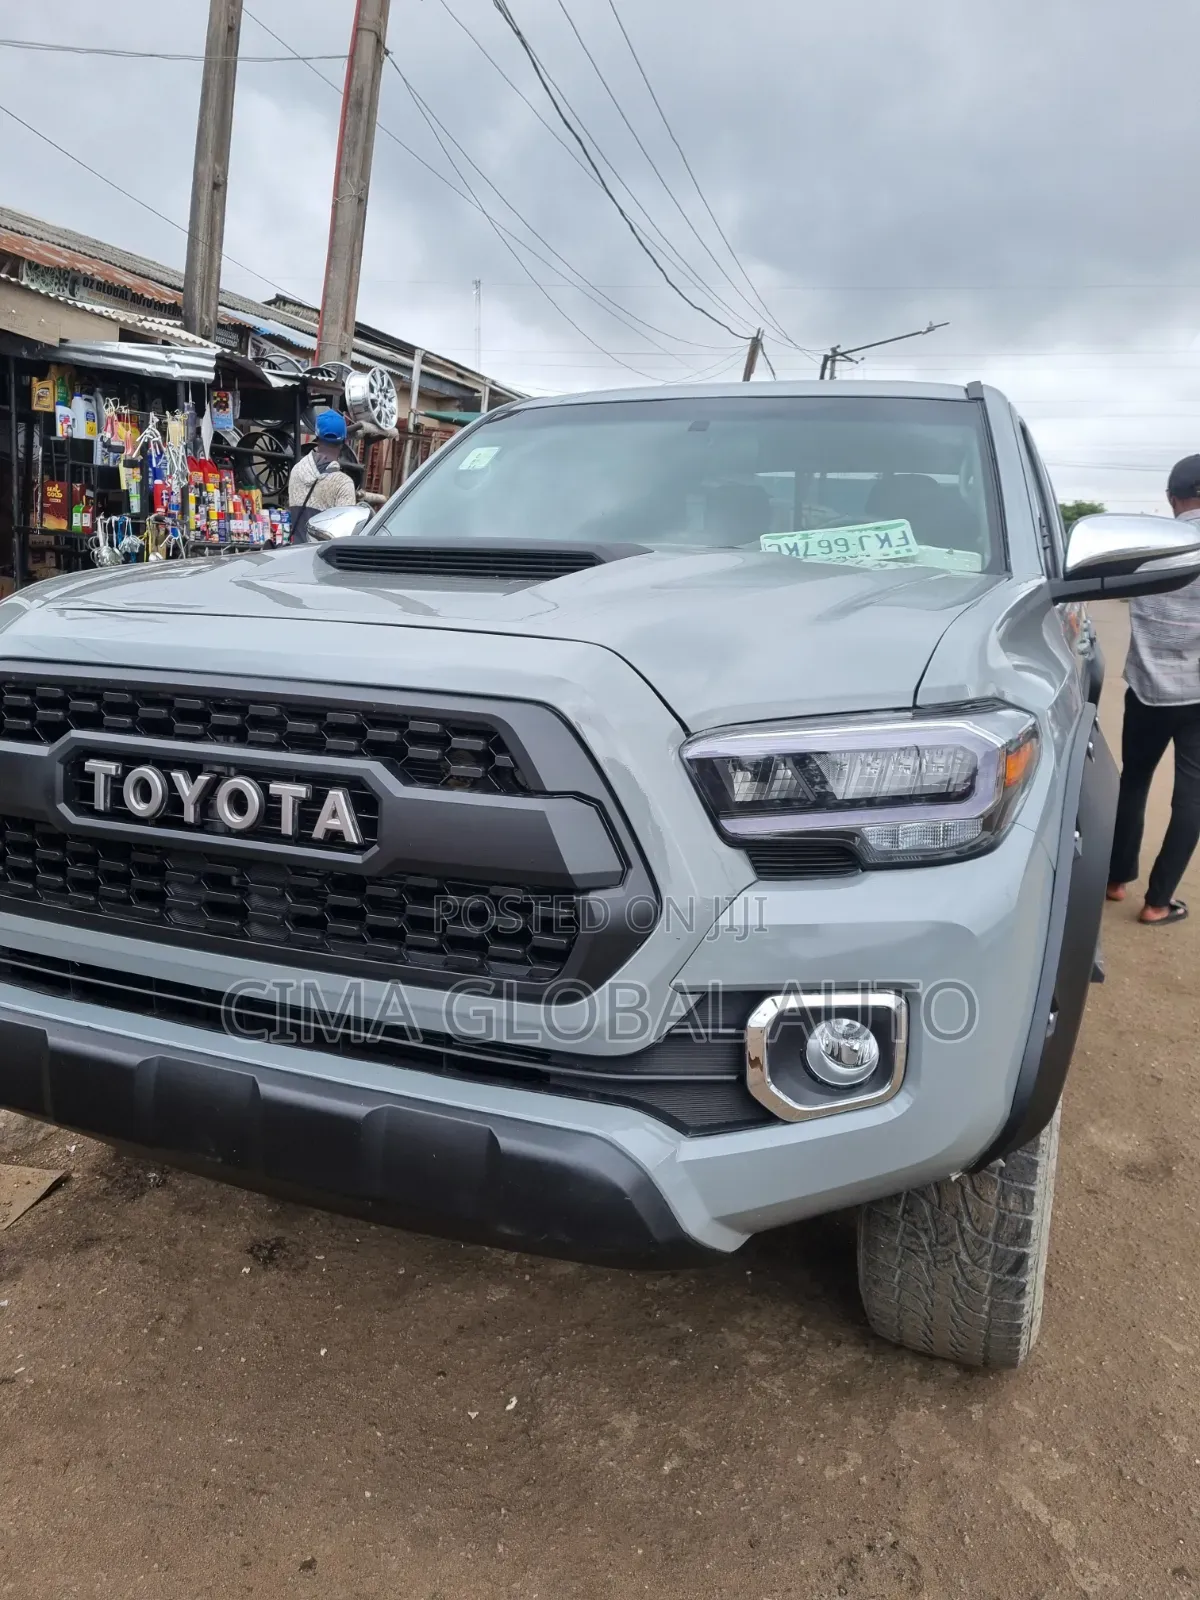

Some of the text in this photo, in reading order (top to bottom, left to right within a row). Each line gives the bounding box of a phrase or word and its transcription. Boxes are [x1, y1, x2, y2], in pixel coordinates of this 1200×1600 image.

[96, 280, 129, 301] GLOBAL
[130, 292, 153, 309] AUTO
[84, 758, 364, 845] TOYOTA
